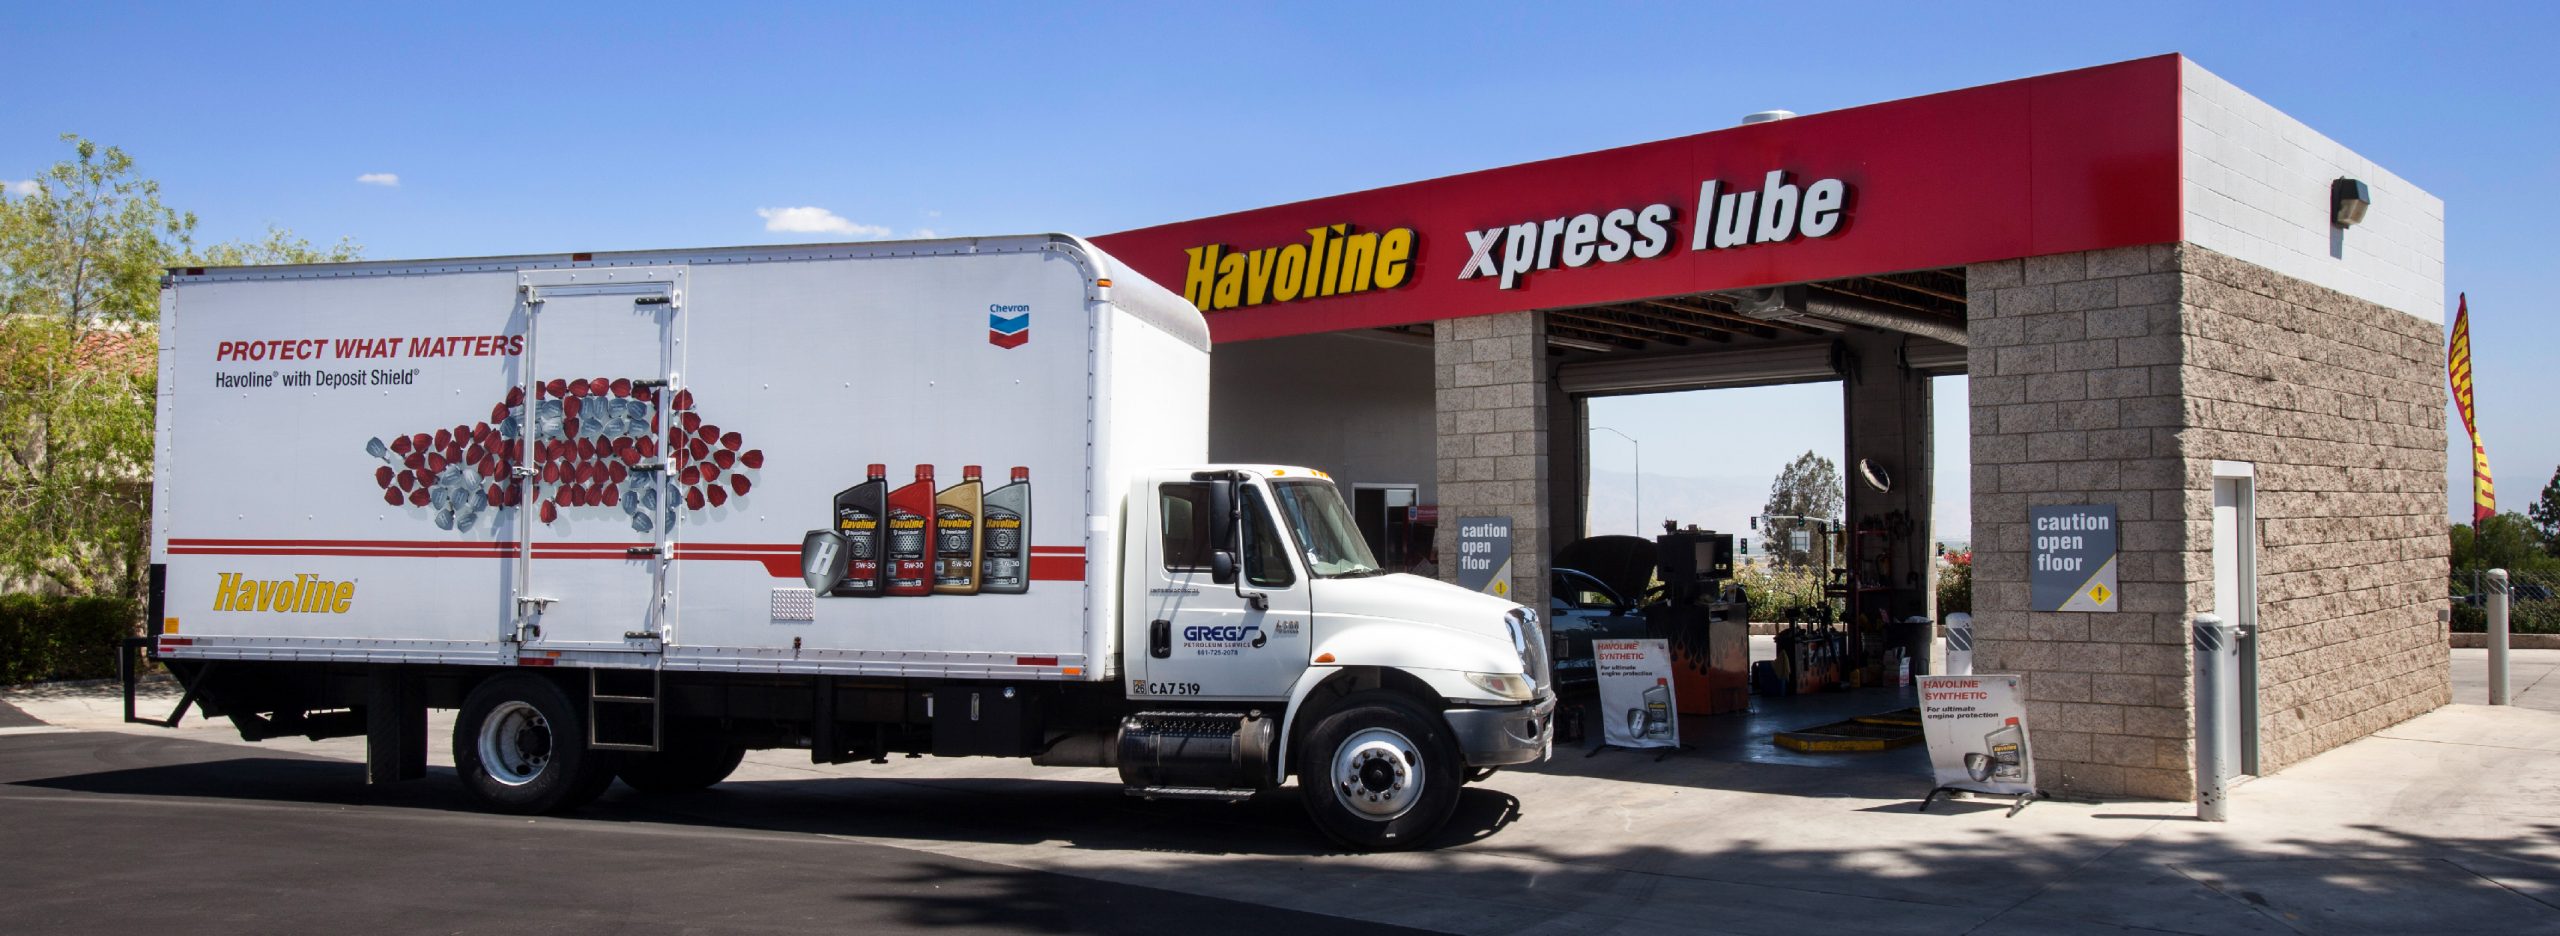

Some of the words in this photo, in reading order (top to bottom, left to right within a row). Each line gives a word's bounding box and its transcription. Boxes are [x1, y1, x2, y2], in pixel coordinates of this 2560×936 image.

[1457, 203, 1673, 290] xpress
[1691, 169, 1847, 252] lube
[1183, 222, 1415, 312] Havoline
[990, 303, 1030, 313] Chevron
[216, 339, 328, 361] PROTECT
[334, 337, 403, 359] WHAT
[407, 335, 524, 358] MATTERS
[282, 369, 311, 386] with
[315, 368, 367, 389] Deposit
[841, 519, 877, 529] Havoline
[889, 519, 924, 529] Havoline
[938, 519, 972, 528] Havoline
[986, 519, 1020, 528] Havoline
[2037, 513, 2109, 531] caution
[1462, 523, 1507, 538] caution
[1462, 541, 1491, 555] open
[2037, 534, 2083, 552] open
[1461, 556, 1491, 570] floor
[2037, 553, 2083, 571] floor
[213, 572, 355, 614] Havoline
[1184, 626, 1259, 641] GREG'S
[1598, 642, 1638, 650] HAVOLINE
[1923, 680, 1980, 688] HAVOLINE
[1925, 692, 1988, 700] SYNTHETIC
